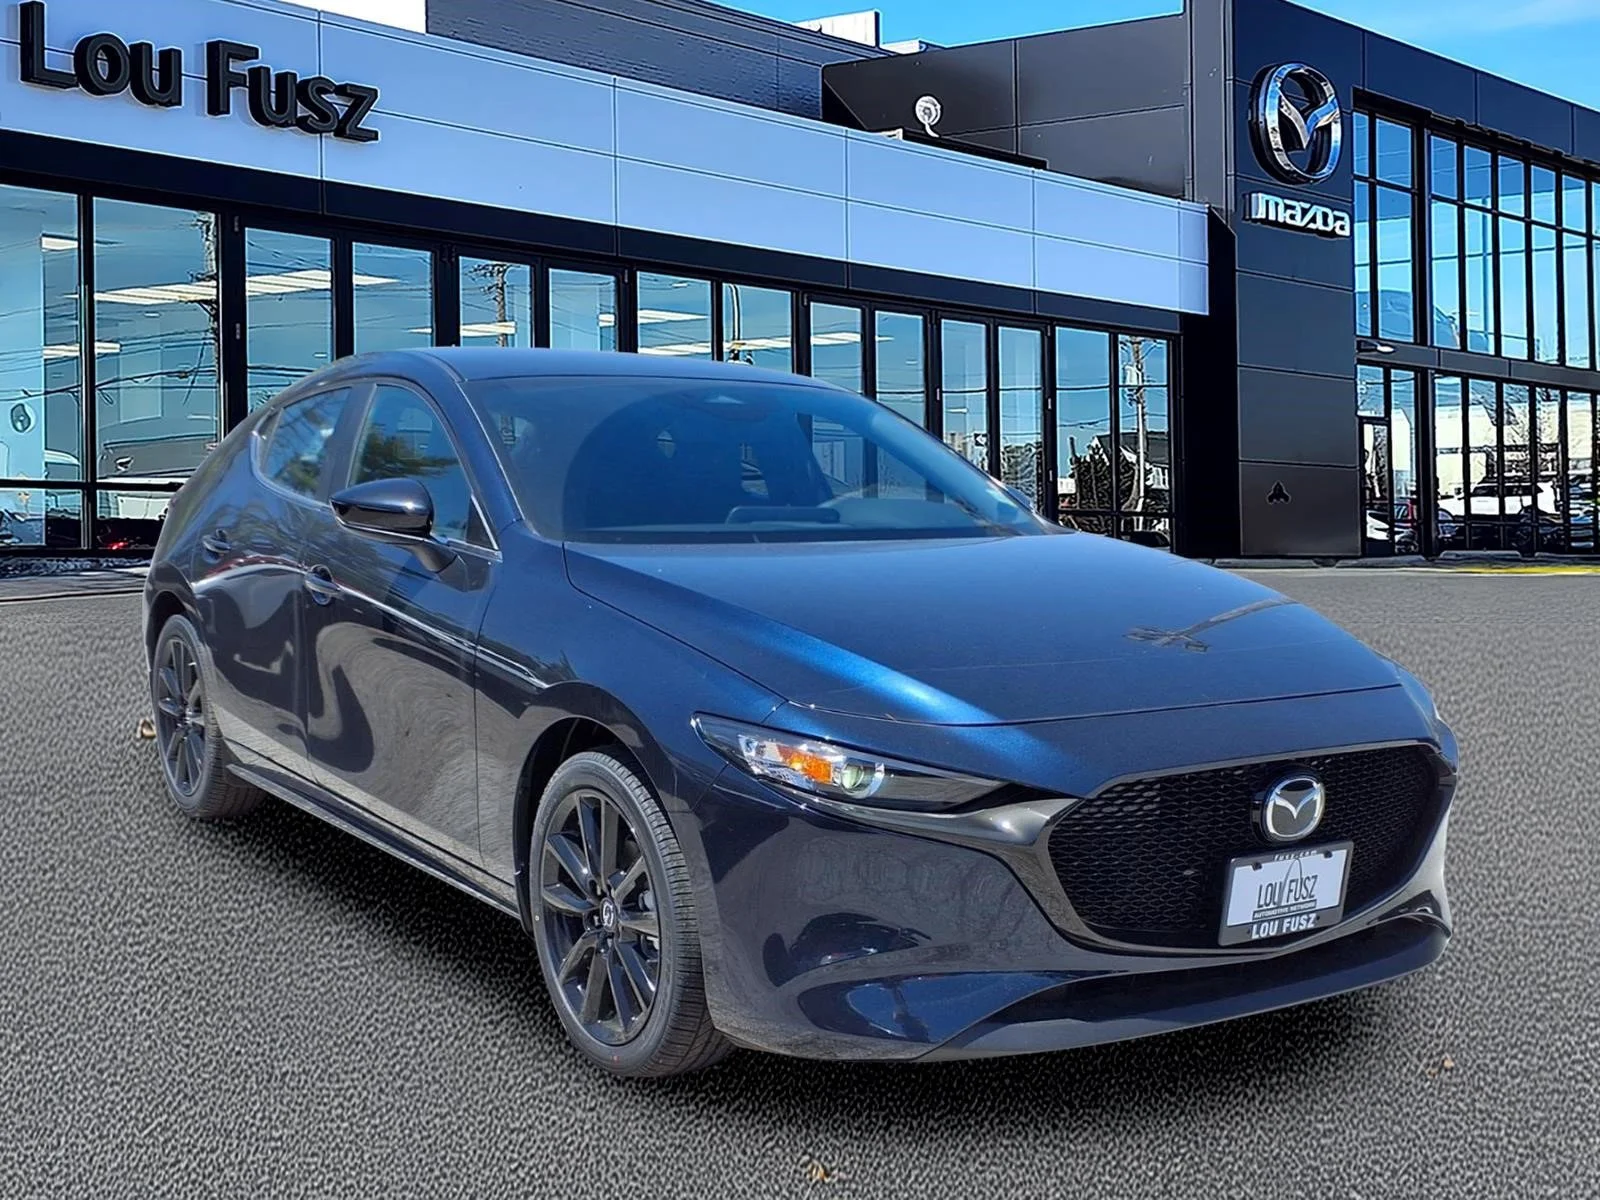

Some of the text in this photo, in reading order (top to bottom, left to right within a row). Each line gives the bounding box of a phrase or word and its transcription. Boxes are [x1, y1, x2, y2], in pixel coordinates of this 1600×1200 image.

[20, 0, 379, 142] Lou Fusz
[1249, 192, 1351, 237] mazda
[1257, 875, 1318, 908] LOU FUSZ
[1252, 913, 1317, 939] LOU FUSZ
